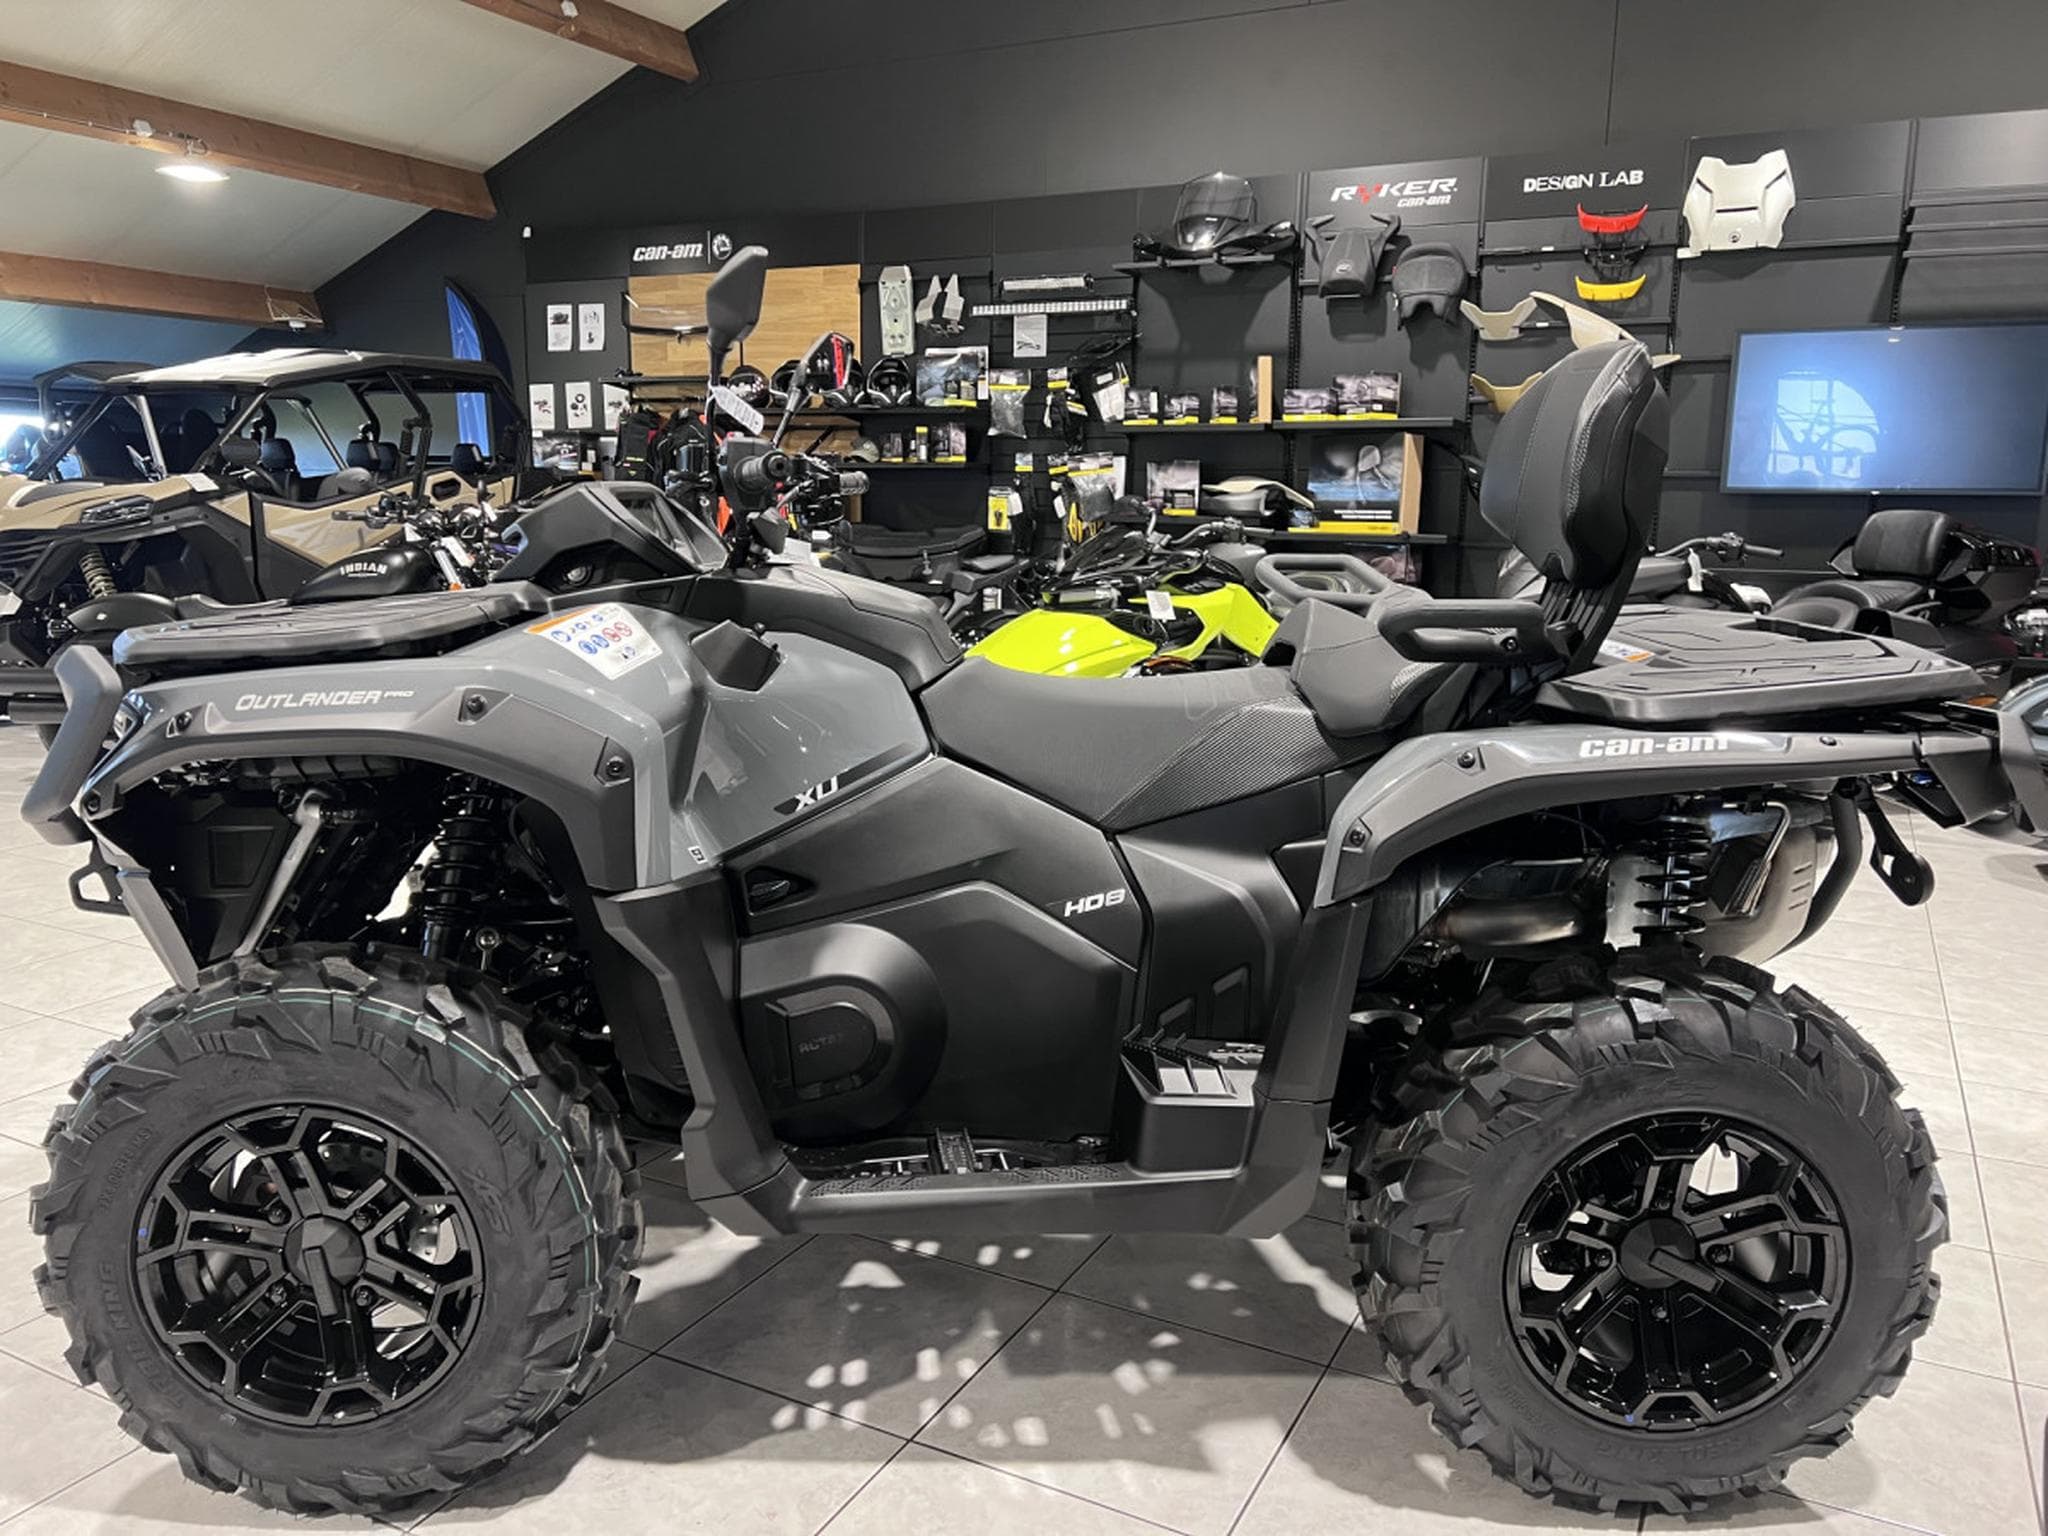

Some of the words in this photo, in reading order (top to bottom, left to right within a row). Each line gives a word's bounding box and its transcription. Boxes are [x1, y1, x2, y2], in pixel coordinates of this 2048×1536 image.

[1331, 177, 1458, 204] RYKER
[1523, 173, 1594, 193] DESIGN
[1599, 169, 1644, 188] LAB
[632, 243, 704, 262] can-am
[340, 562, 388, 576] INDIAN
[235, 690, 383, 711] OUTLANDER
[383, 690, 416, 699] PRO
[1579, 735, 1729, 758] can-am
[1064, 888, 1126, 917] HD8
